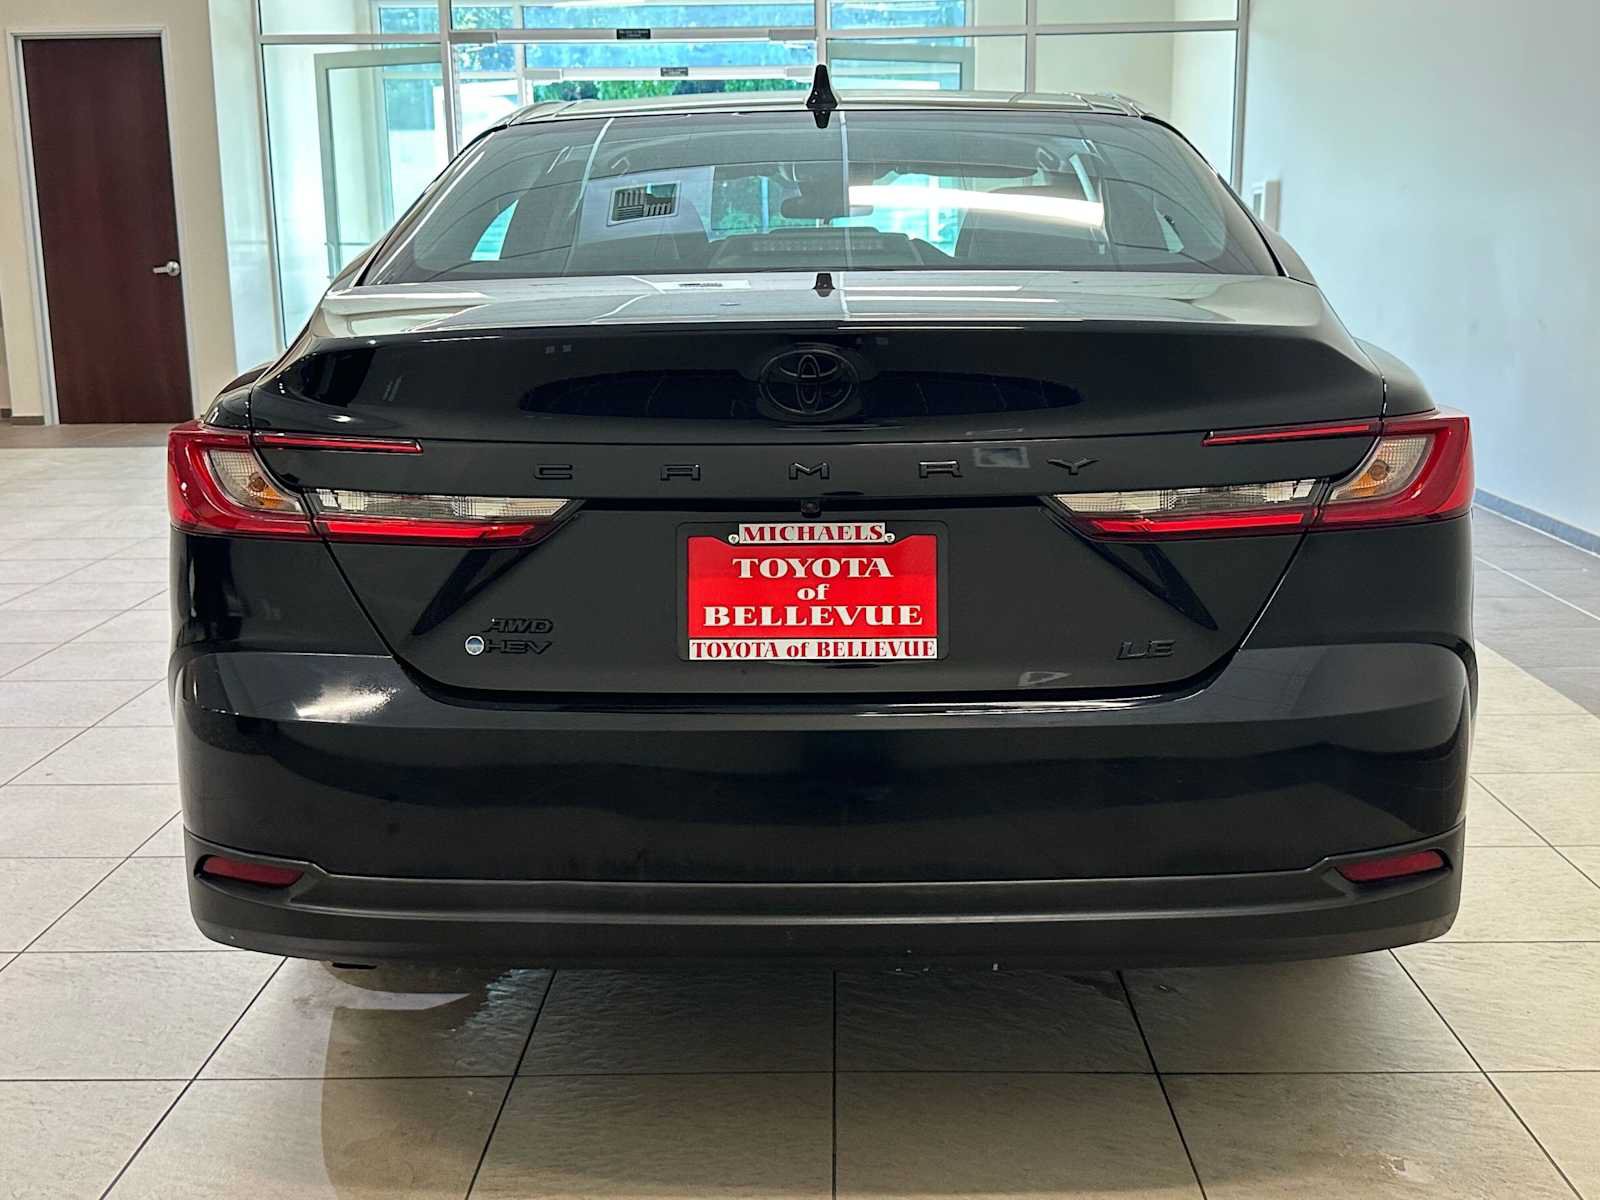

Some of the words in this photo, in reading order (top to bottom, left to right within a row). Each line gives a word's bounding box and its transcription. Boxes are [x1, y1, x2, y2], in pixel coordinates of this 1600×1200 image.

[532, 457, 1099, 481] CAMRY
[743, 524, 883, 543] MICHAELS
[732, 557, 894, 579] TOYOTA
[796, 583, 830, 601] of
[483, 617, 553, 634] AWD
[703, 605, 923, 627] BELLEVUE
[486, 639, 553, 655] HEV
[691, 641, 778, 658] TOYOTA
[786, 642, 810, 658] of
[817, 641, 935, 657] BELLEVUE
[1116, 639, 1176, 660] LE
